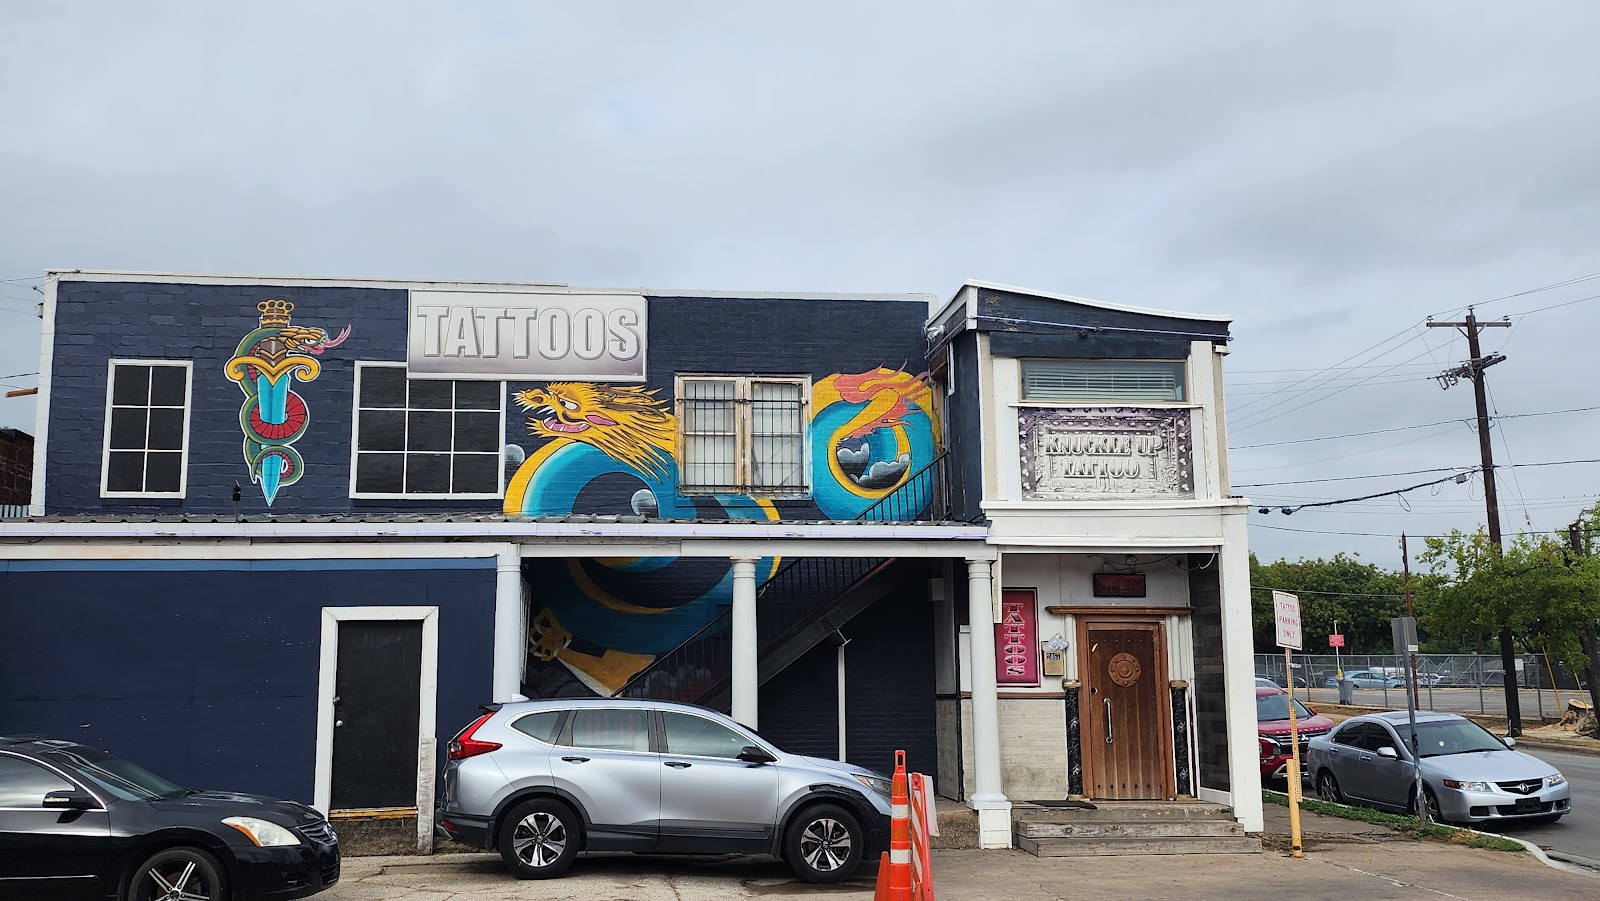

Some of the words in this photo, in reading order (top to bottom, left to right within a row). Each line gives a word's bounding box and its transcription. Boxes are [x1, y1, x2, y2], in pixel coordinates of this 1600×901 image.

[417, 305, 640, 361] TATTOOS
[1045, 435, 1132, 456] KNUCKLE
[1135, 435, 1163, 456] UP
[1062, 458, 1140, 478] TATTOO
[1280, 602, 1296, 613] TATTOO
[1279, 616, 1298, 627] PARKING
[1003, 602, 1026, 675] TATTOOS
[1283, 629, 1295, 639] ONLY
